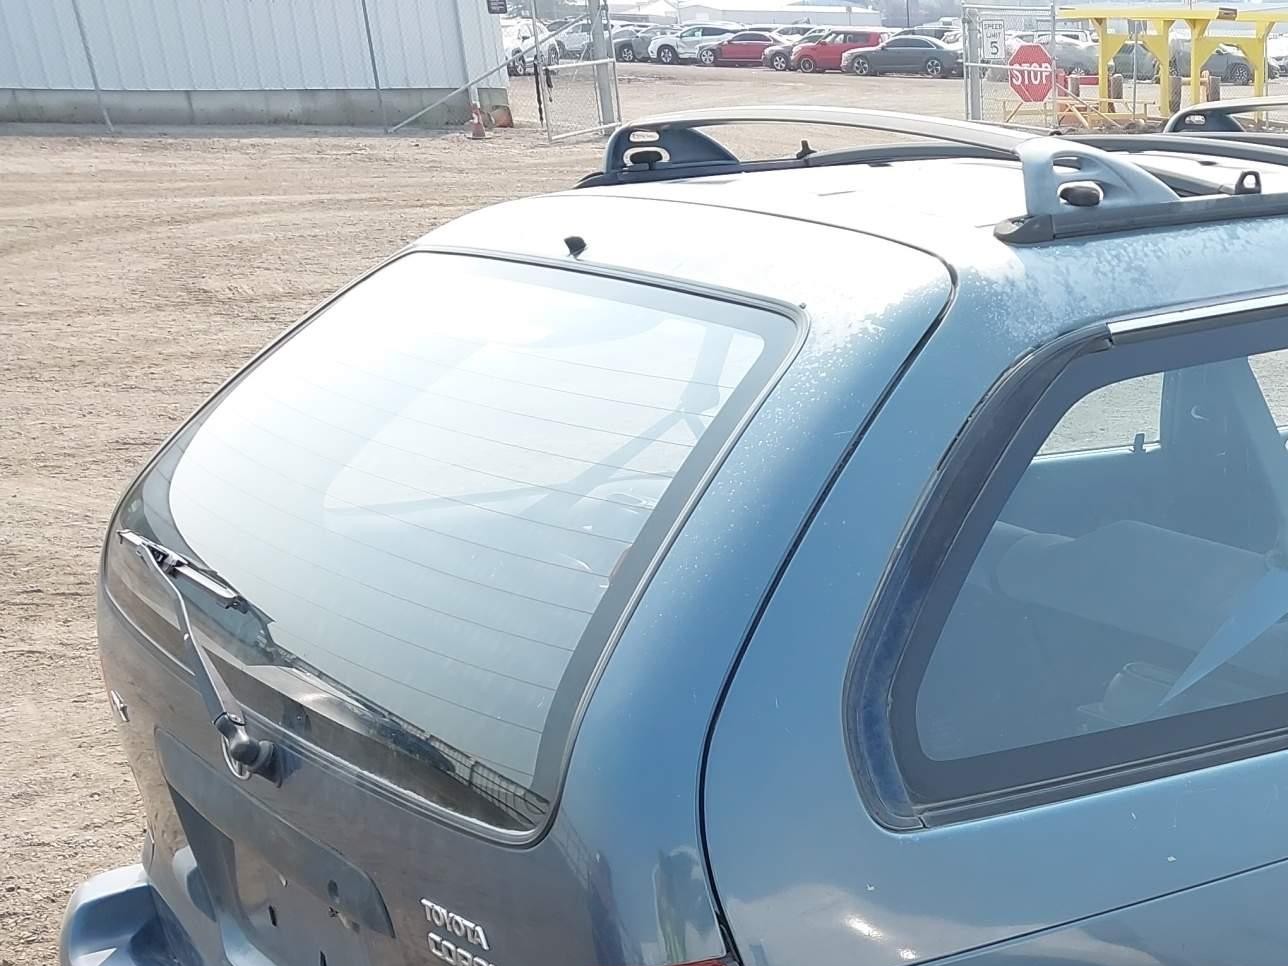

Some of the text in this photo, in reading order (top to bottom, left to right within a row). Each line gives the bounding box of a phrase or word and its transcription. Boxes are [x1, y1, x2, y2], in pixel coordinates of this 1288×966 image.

[990, 40, 999, 55] 5
[1011, 62, 1052, 85] STOP
[420, 898, 490, 951] TOYOTA
